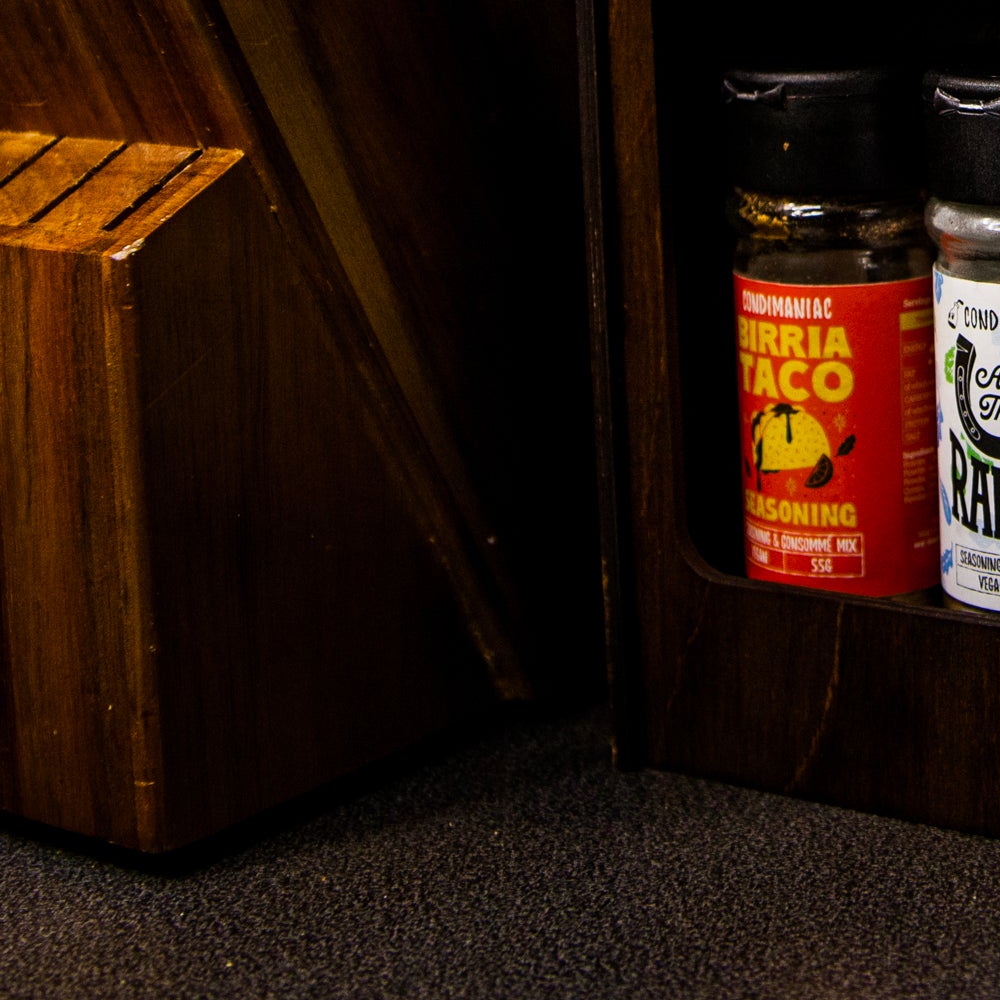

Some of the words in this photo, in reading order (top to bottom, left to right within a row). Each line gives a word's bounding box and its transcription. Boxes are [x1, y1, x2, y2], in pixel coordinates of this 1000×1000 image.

[742, 289, 832, 319] CONDIMANIAC
[737, 314, 853, 359] BIRRIA
[739, 351, 855, 404] TACO
[836, 538, 858, 553] MIX
